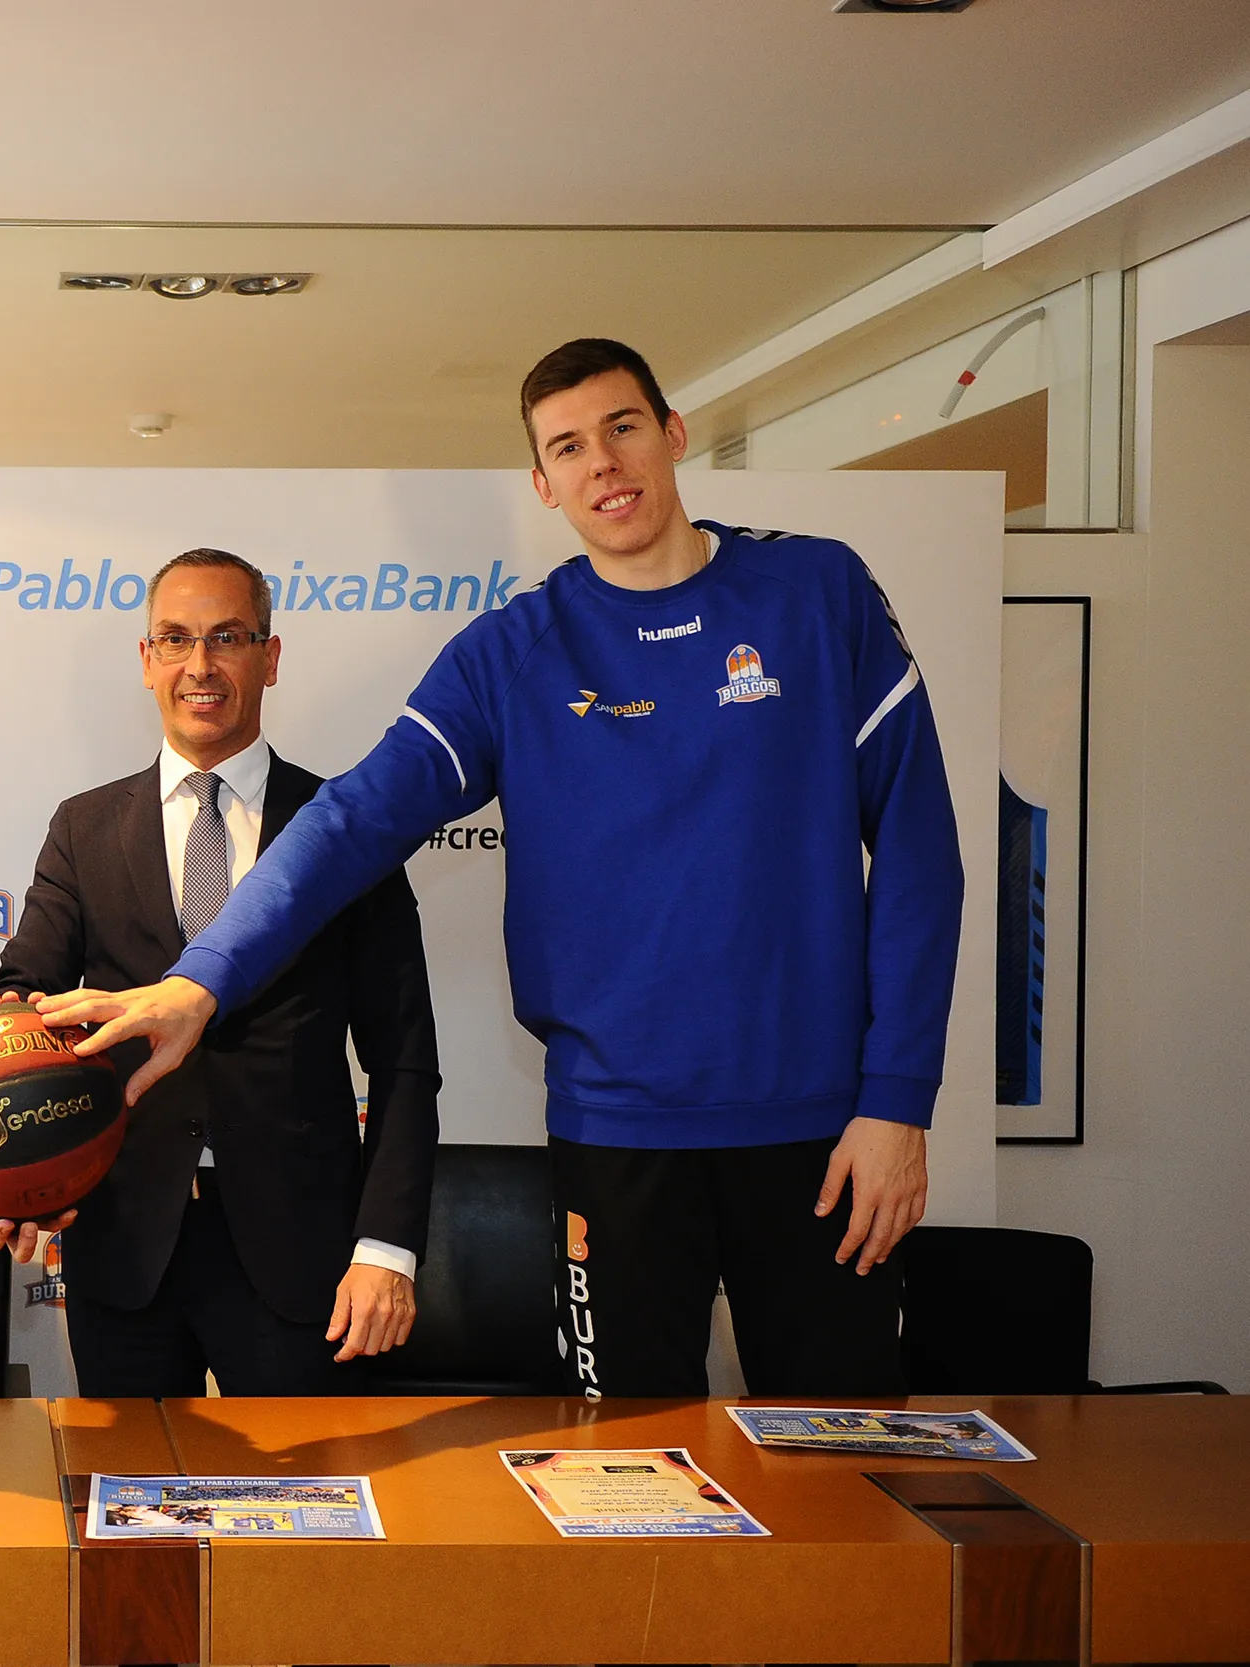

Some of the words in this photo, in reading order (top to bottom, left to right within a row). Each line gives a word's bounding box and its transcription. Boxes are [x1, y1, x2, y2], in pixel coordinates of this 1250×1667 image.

[263, 560, 520, 612] aixaBank
[637, 615, 702, 642] hummel
[721, 681, 777, 701] BURGOS
[6, 1094, 94, 1131] endesa
